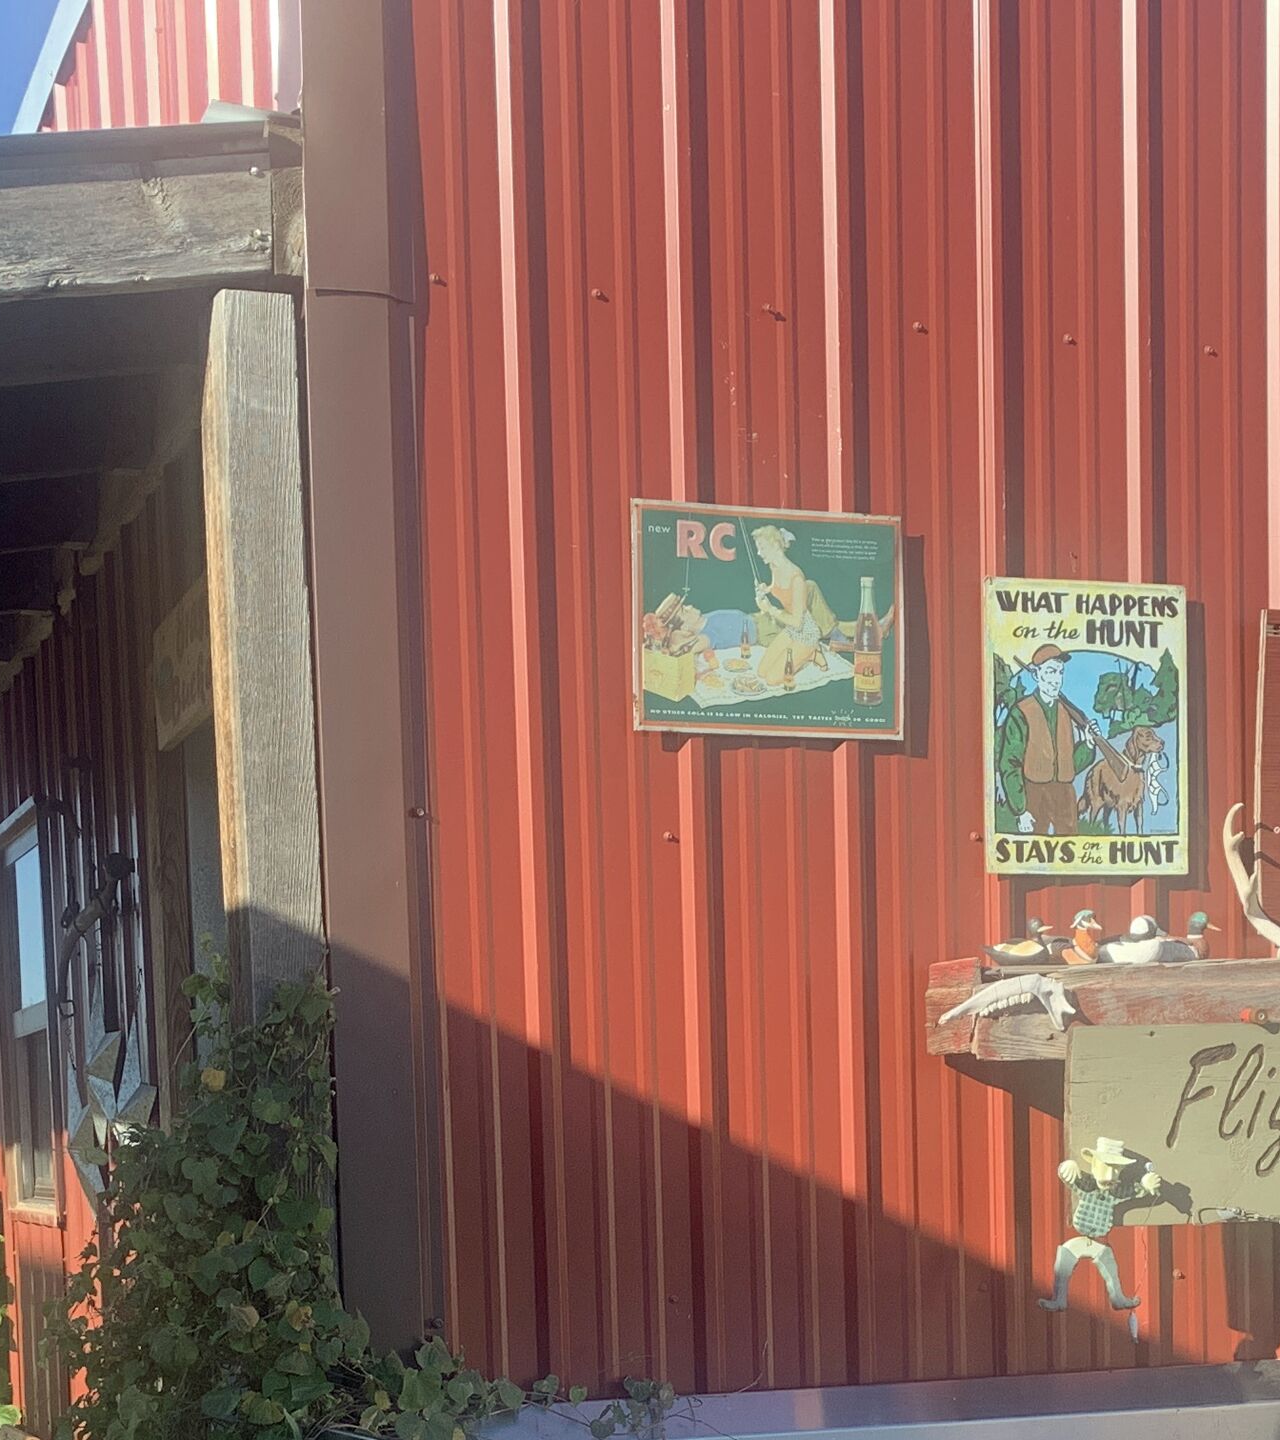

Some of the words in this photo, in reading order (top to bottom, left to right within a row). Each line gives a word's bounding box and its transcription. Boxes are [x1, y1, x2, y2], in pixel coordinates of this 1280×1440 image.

[647, 525, 671, 533] new
[676, 519, 737, 562] RC
[995, 590, 1069, 613] WHAT
[1075, 593, 1179, 618] HAPPENS
[1012, 624, 1040, 639] on
[1043, 620, 1080, 640] the
[1085, 619, 1163, 649] HUNT
[995, 837, 1075, 864] STAYS
[1078, 852, 1103, 865] the
[1082, 841, 1103, 851] on
[1108, 840, 1179, 865] HUNT
